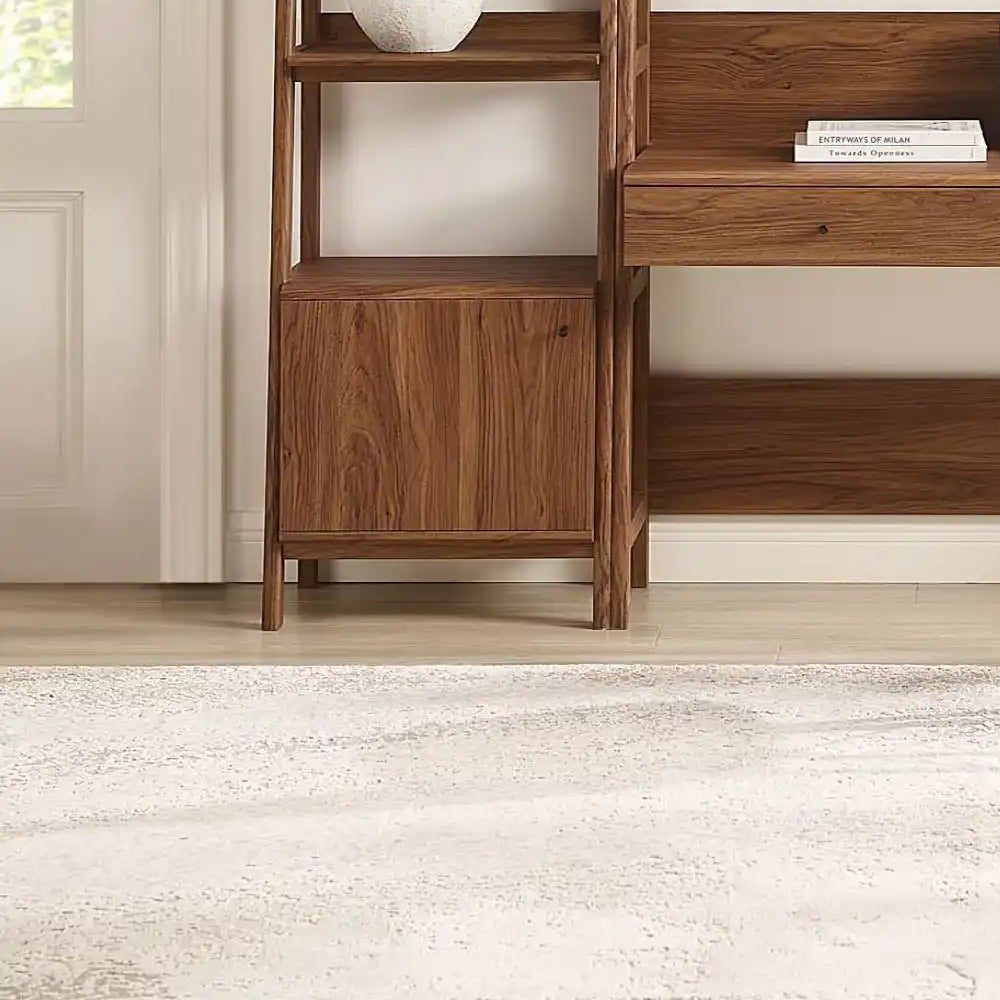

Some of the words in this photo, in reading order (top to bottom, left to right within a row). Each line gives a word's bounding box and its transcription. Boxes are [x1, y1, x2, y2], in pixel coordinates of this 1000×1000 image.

[818, 136, 869, 144] ENTRYWAYS
[870, 136, 882, 144] OF
[883, 136, 911, 144] MILAN
[828, 149, 867, 157] Towards
[870, 149, 915, 158] Openness
